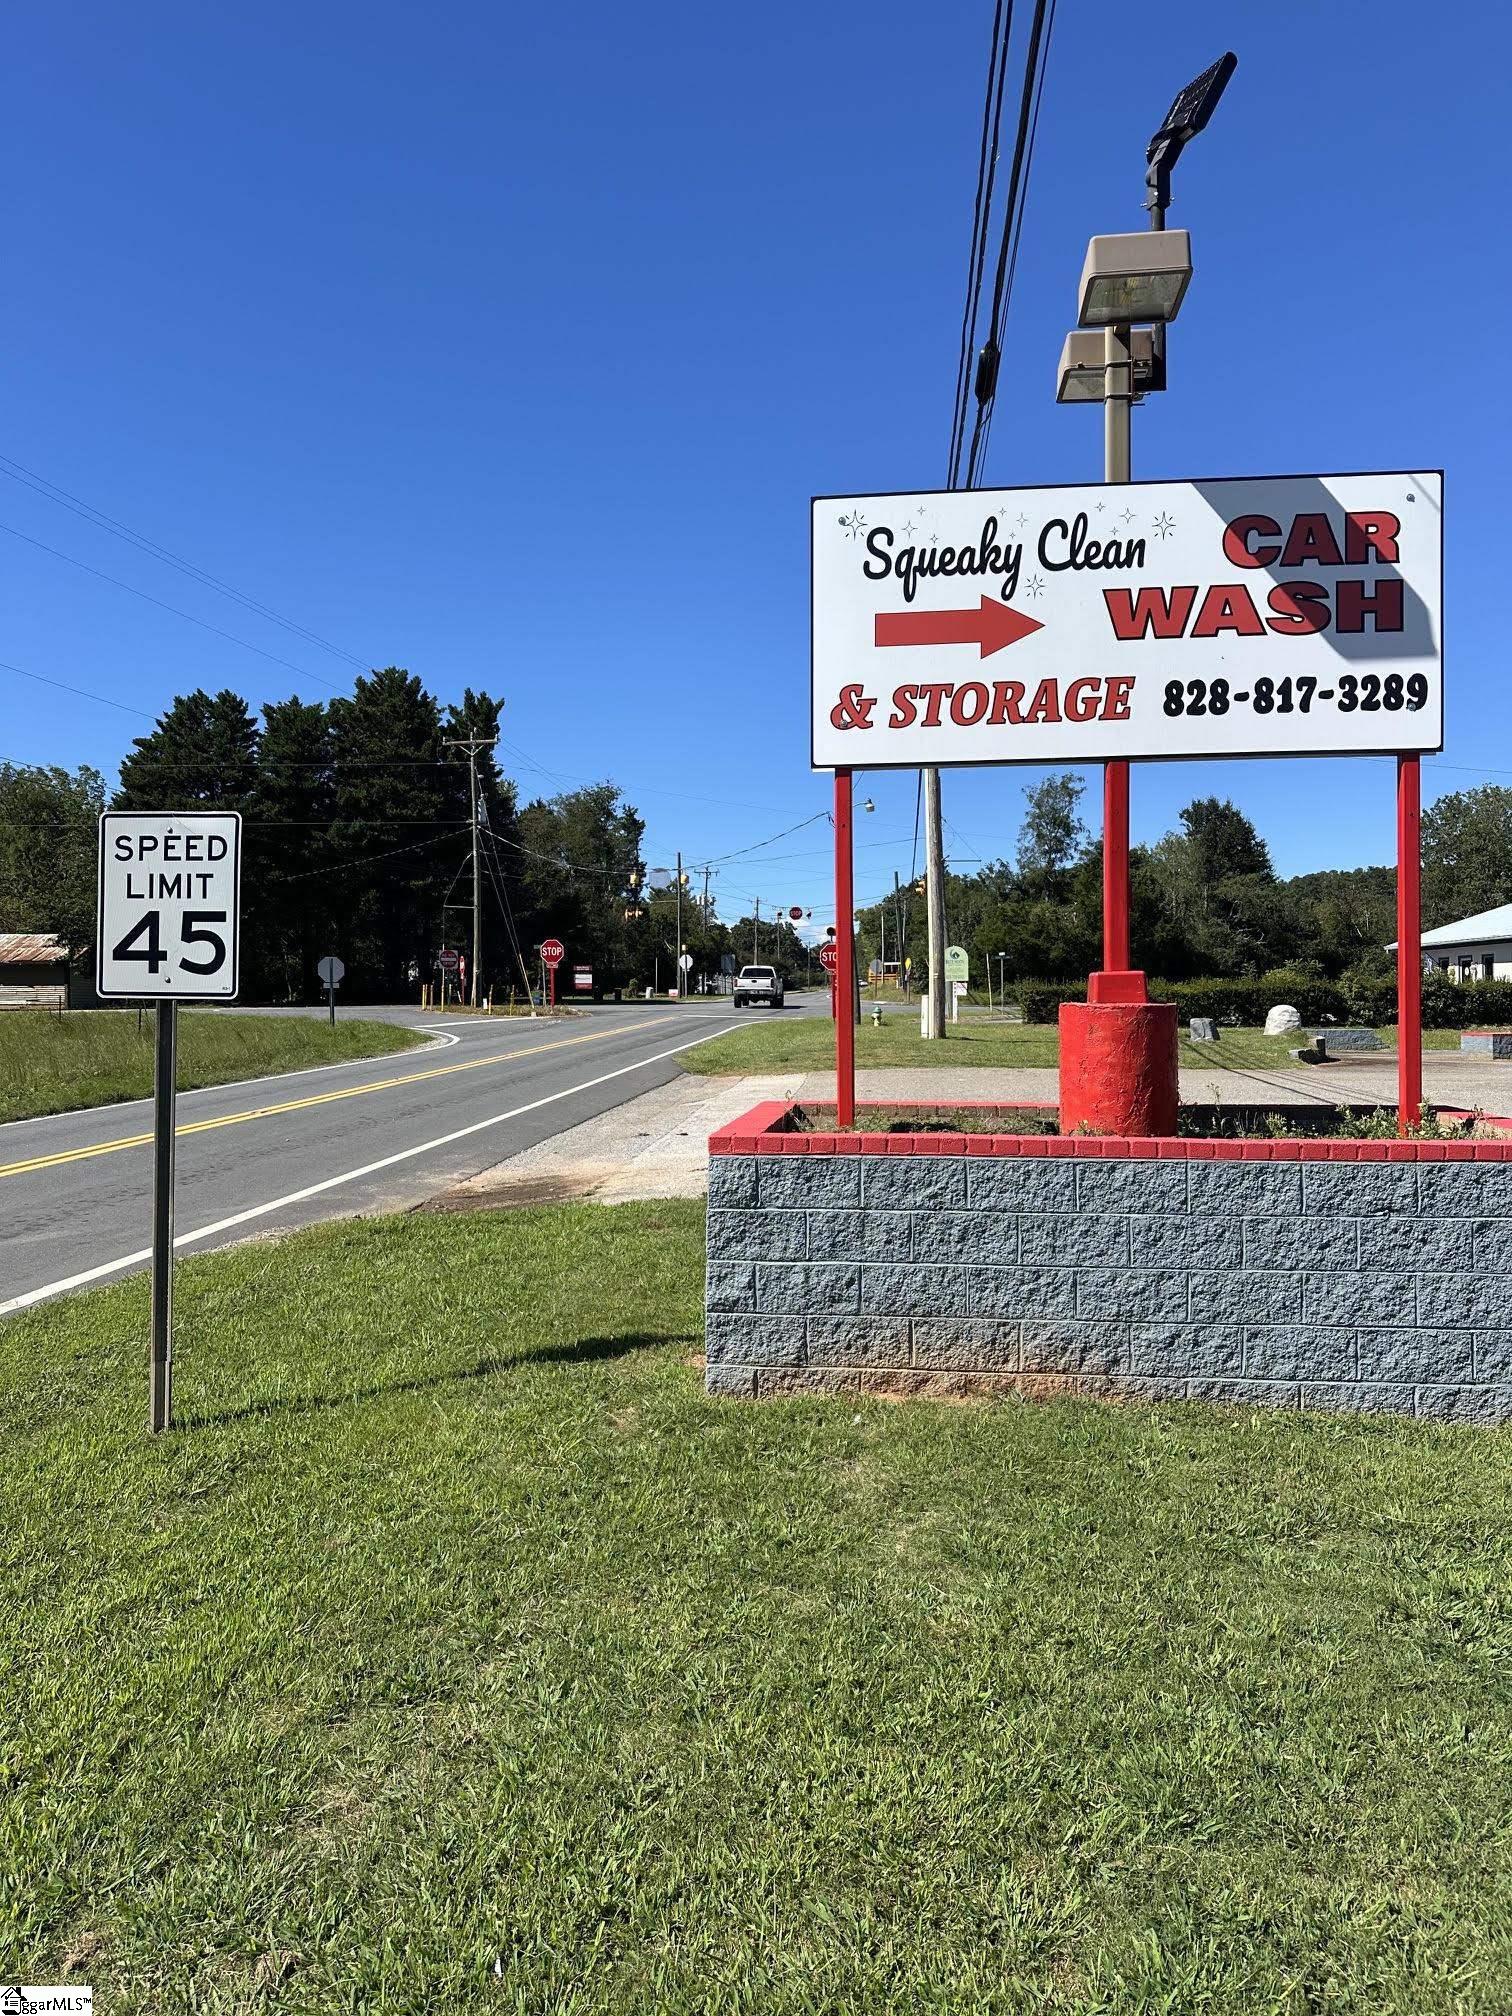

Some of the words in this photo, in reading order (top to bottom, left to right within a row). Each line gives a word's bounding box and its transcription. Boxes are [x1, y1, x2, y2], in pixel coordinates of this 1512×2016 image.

[863, 515, 1022, 602] Squeaky
[1037, 511, 1146, 572] Clean
[1222, 510, 1401, 569] CAR
[1101, 579, 1405, 641] WASH
[829, 683, 878, 730] &
[888, 675, 1136, 729] STORAGE
[1162, 672, 1429, 717] 828-817-3289
[114, 835, 228, 862] SPEED
[126, 873, 214, 899] LIMIT
[112, 910, 227, 976] 45
[542, 946, 562, 956] STOP
[821, 951, 838, 962] STO
